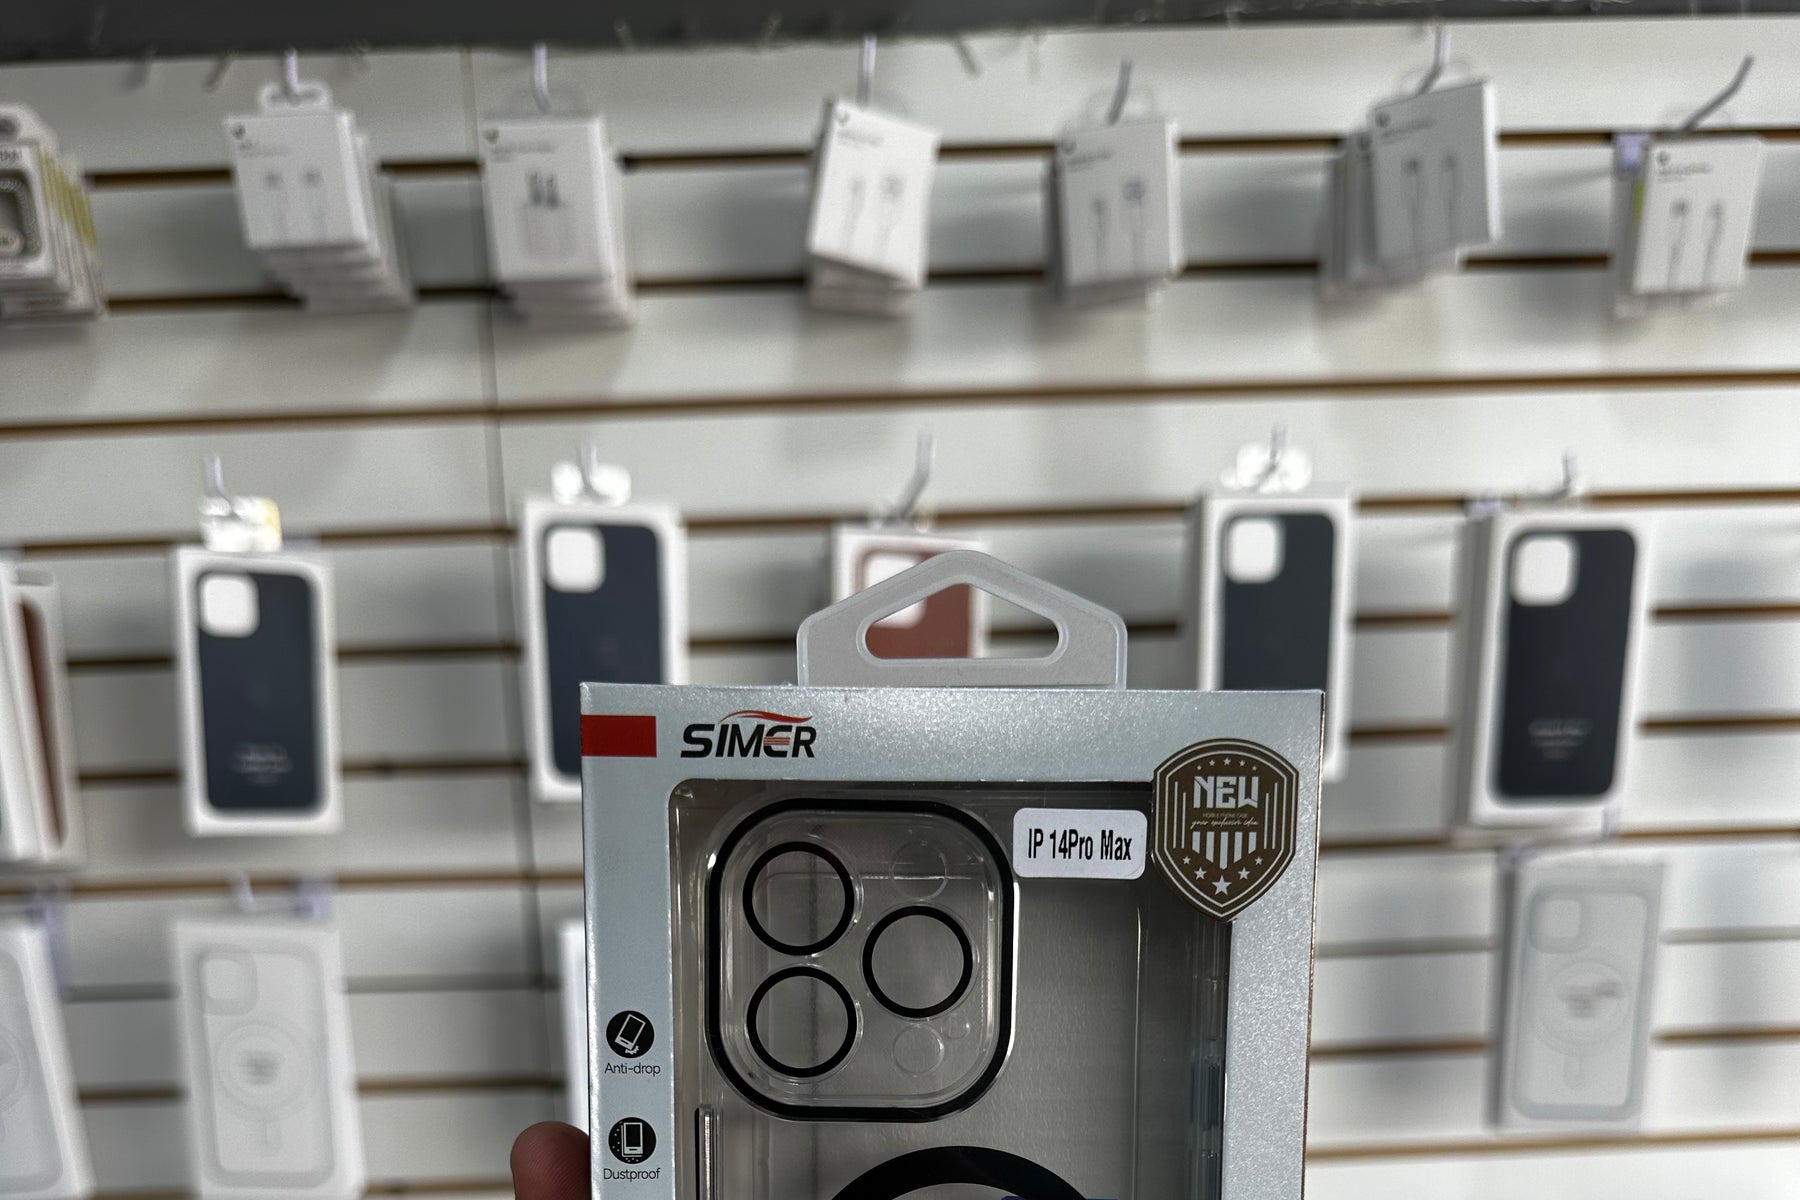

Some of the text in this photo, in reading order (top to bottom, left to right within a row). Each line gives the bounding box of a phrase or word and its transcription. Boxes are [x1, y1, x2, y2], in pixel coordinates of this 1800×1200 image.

[680, 722, 817, 758] SIMER
[1193, 776, 1259, 809] NEW
[1028, 828, 1133, 861] IP 14Pro Max
[604, 1063, 661, 1076] Anti-drop
[603, 1168, 661, 1181] Dustproof
